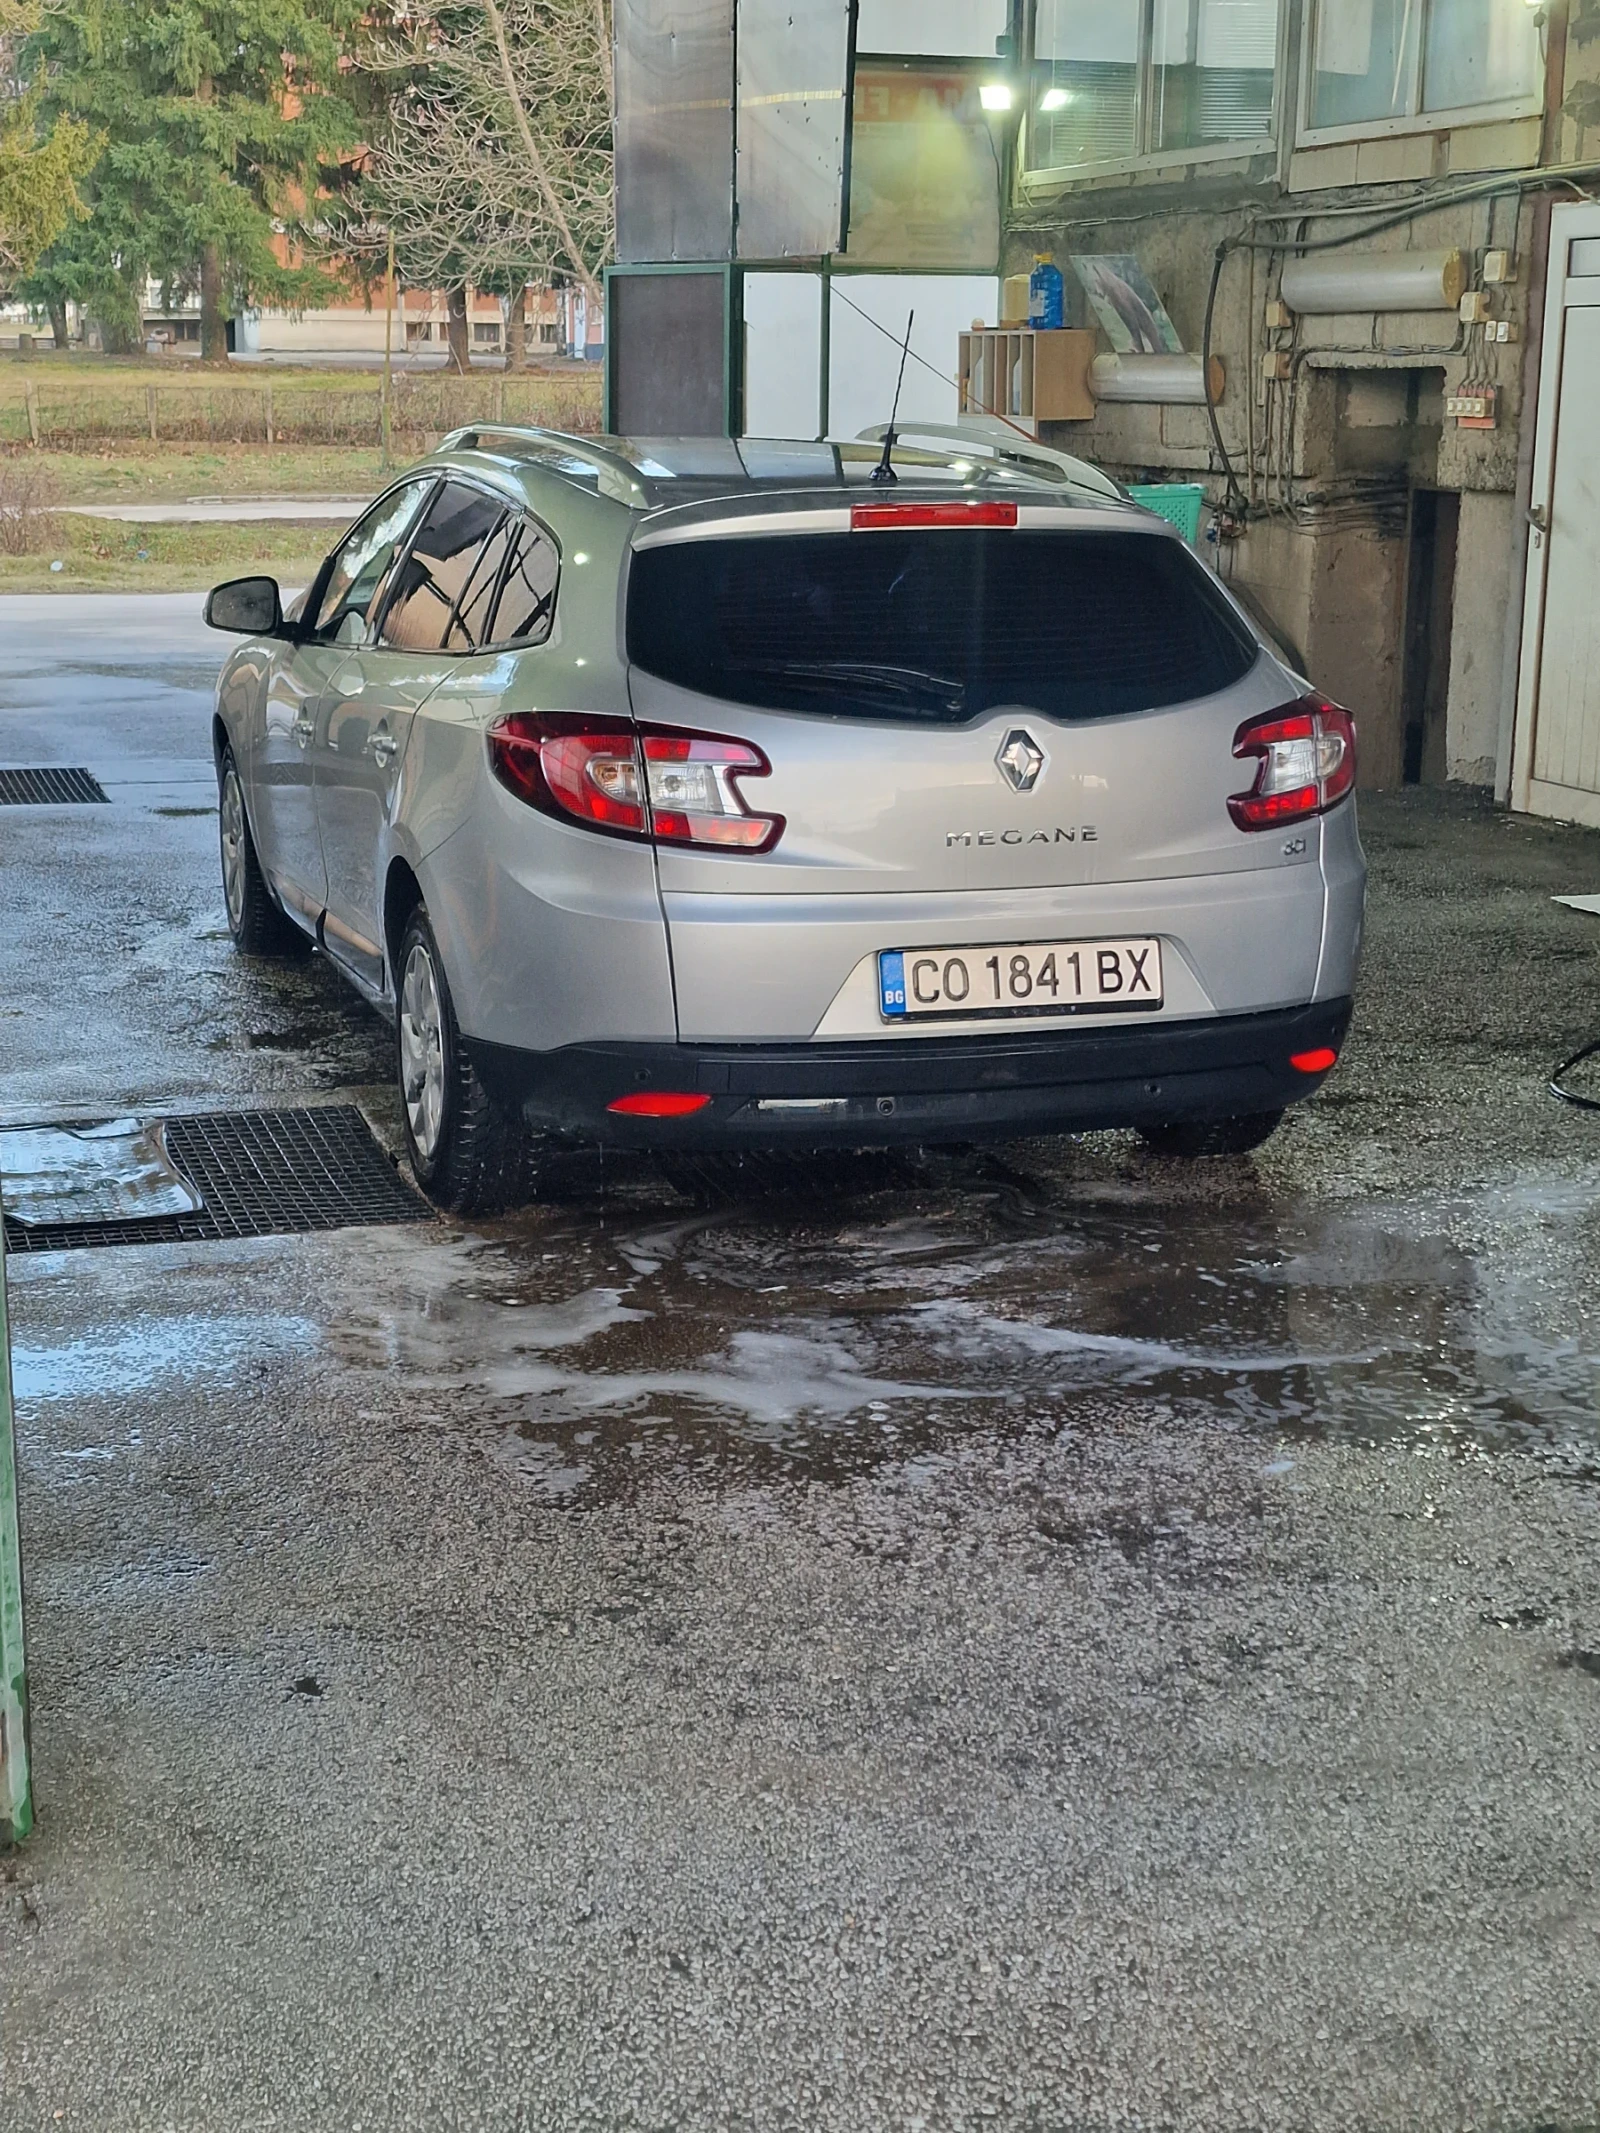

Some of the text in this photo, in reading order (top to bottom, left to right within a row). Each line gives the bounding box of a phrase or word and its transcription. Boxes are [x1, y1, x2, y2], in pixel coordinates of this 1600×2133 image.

[946, 825, 1098, 847] MEGANE
[912, 948, 1152, 1003] CO 1841 BX
[884, 990, 904, 1005] BG
